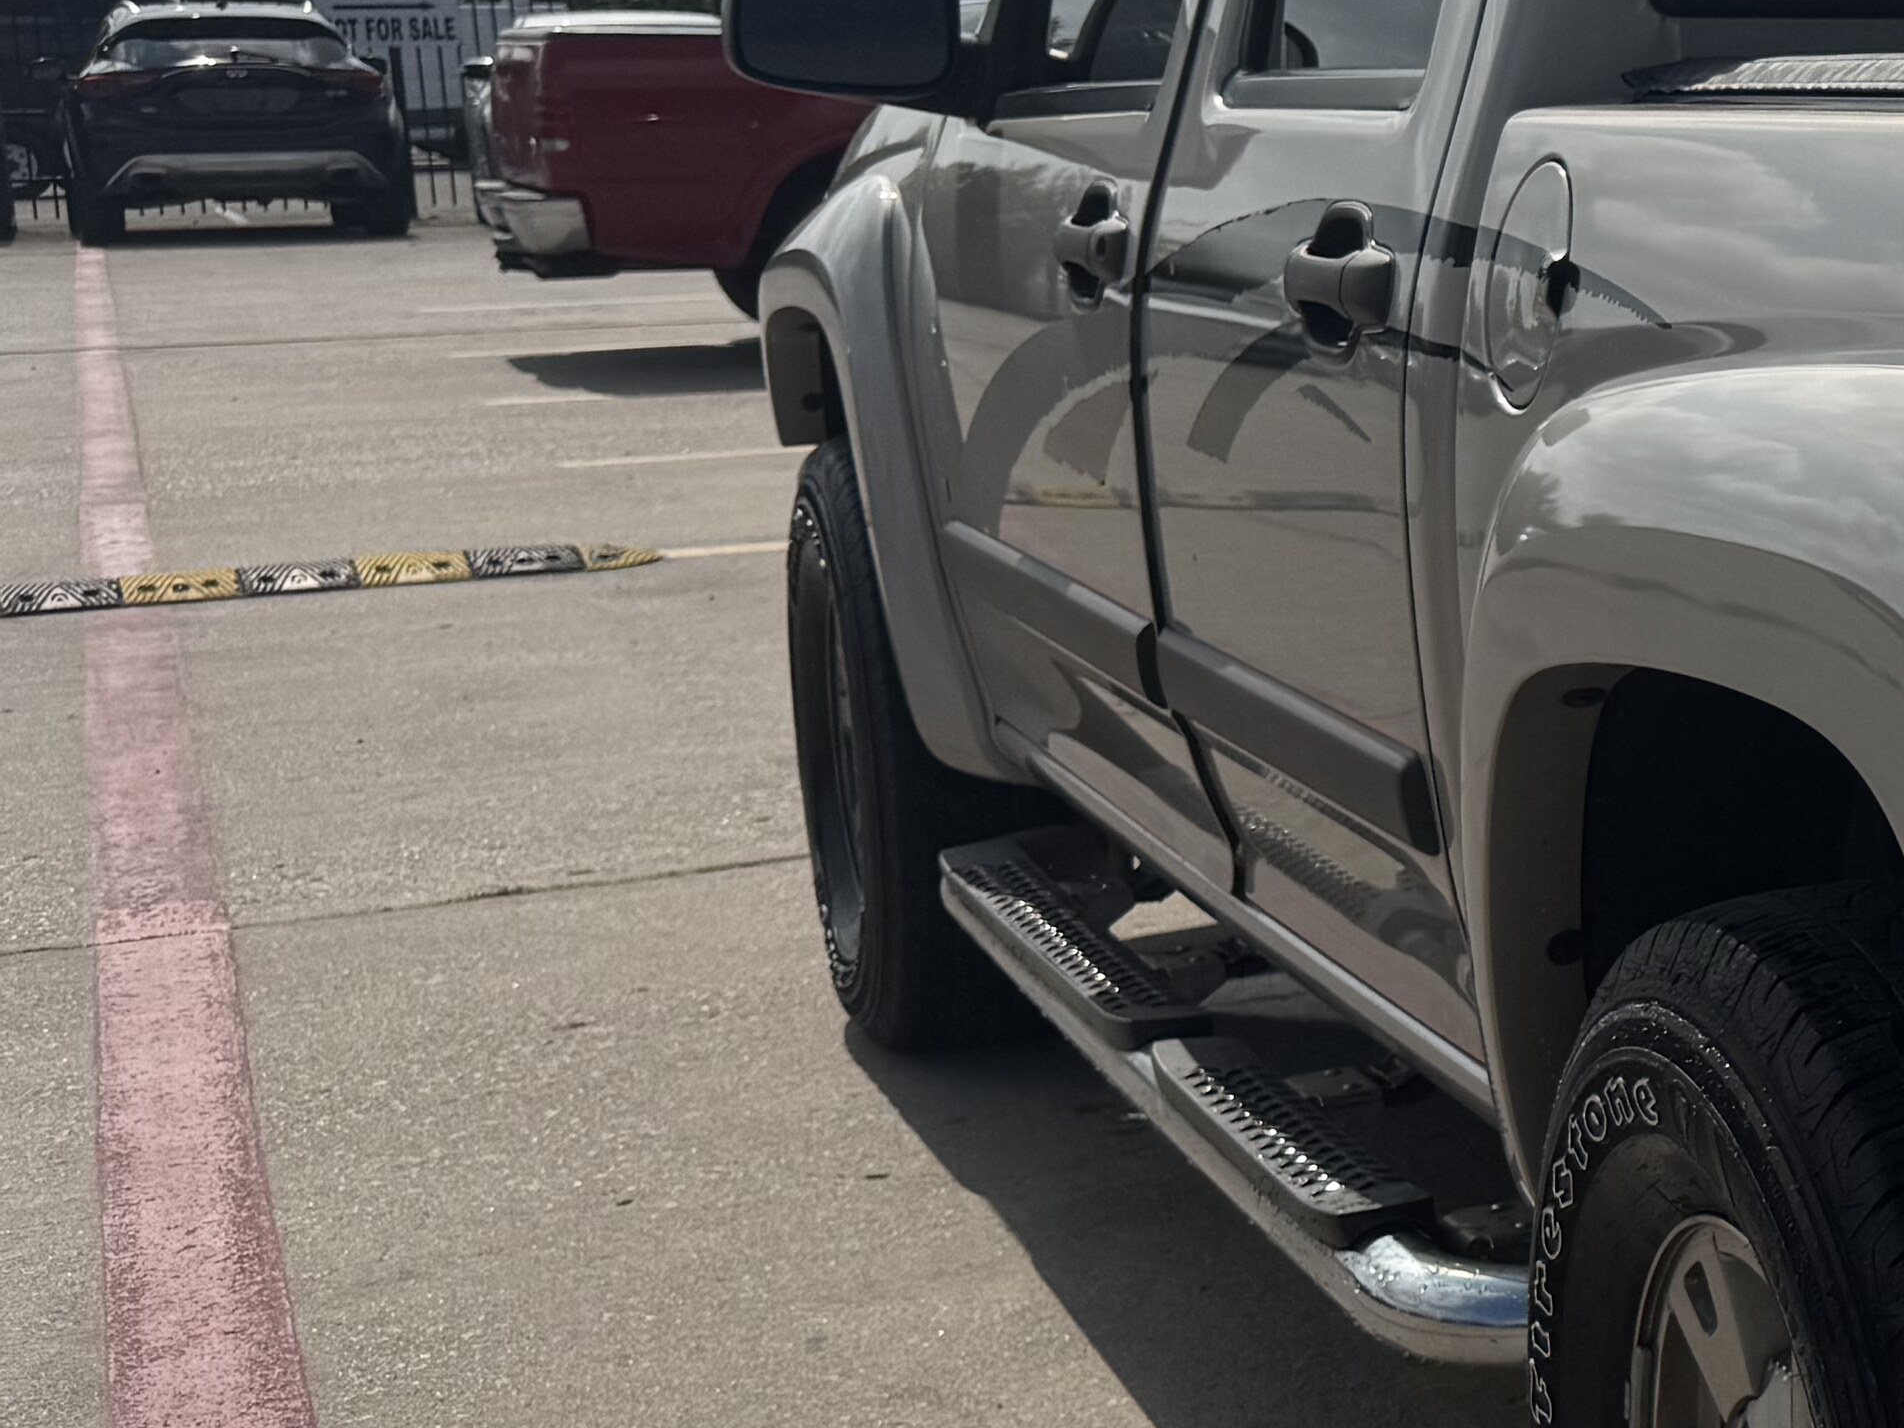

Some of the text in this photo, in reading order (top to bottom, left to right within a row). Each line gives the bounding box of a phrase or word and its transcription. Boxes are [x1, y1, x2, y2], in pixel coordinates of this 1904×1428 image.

[365, 17, 403, 42] FOR
[409, 17, 457, 42] SALE
[1528, 1074, 1660, 1426] Firestone
